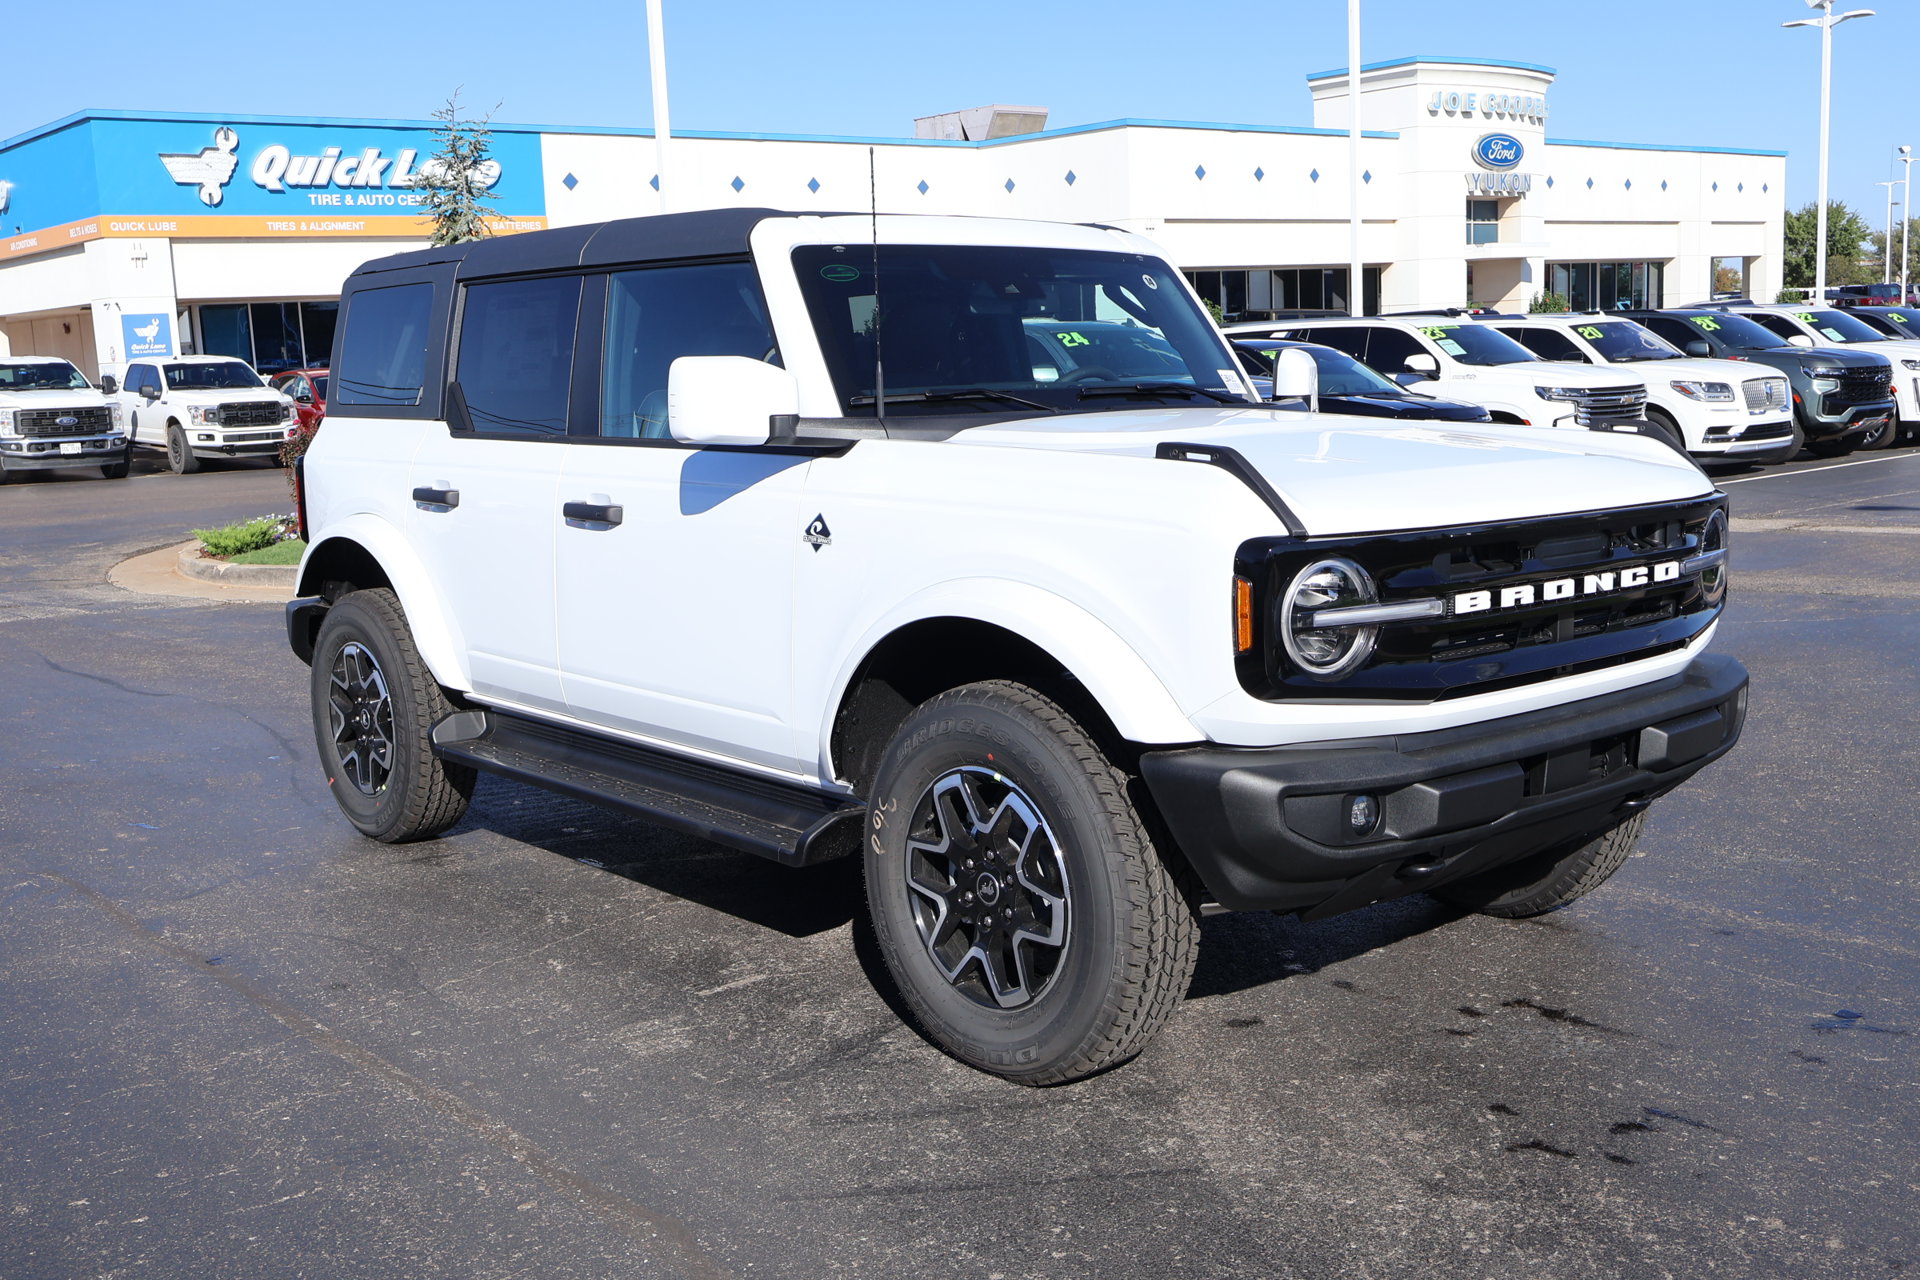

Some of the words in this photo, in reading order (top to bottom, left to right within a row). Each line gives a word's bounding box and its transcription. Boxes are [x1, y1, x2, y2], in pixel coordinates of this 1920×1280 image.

[1428, 91, 1477, 113] JOE
[1488, 139, 1516, 160] Ford
[251, 144, 393, 192] Quick
[1467, 173, 1531, 192] YUKON
[308, 194, 342, 206] TIRE
[344, 194, 354, 206] &
[357, 194, 395, 206] AUTO
[110, 221, 146, 232] QUICK
[148, 221, 177, 232] LUBE
[266, 221, 296, 231] TIRES
[300, 221, 309, 231] &
[310, 221, 365, 231] ALIGNMENT
[492, 221, 541, 230] BATTERIES
[1057, 331, 1091, 348] 24
[1577, 326, 1605, 340] 20
[1454, 560, 1681, 615] BRONCO
